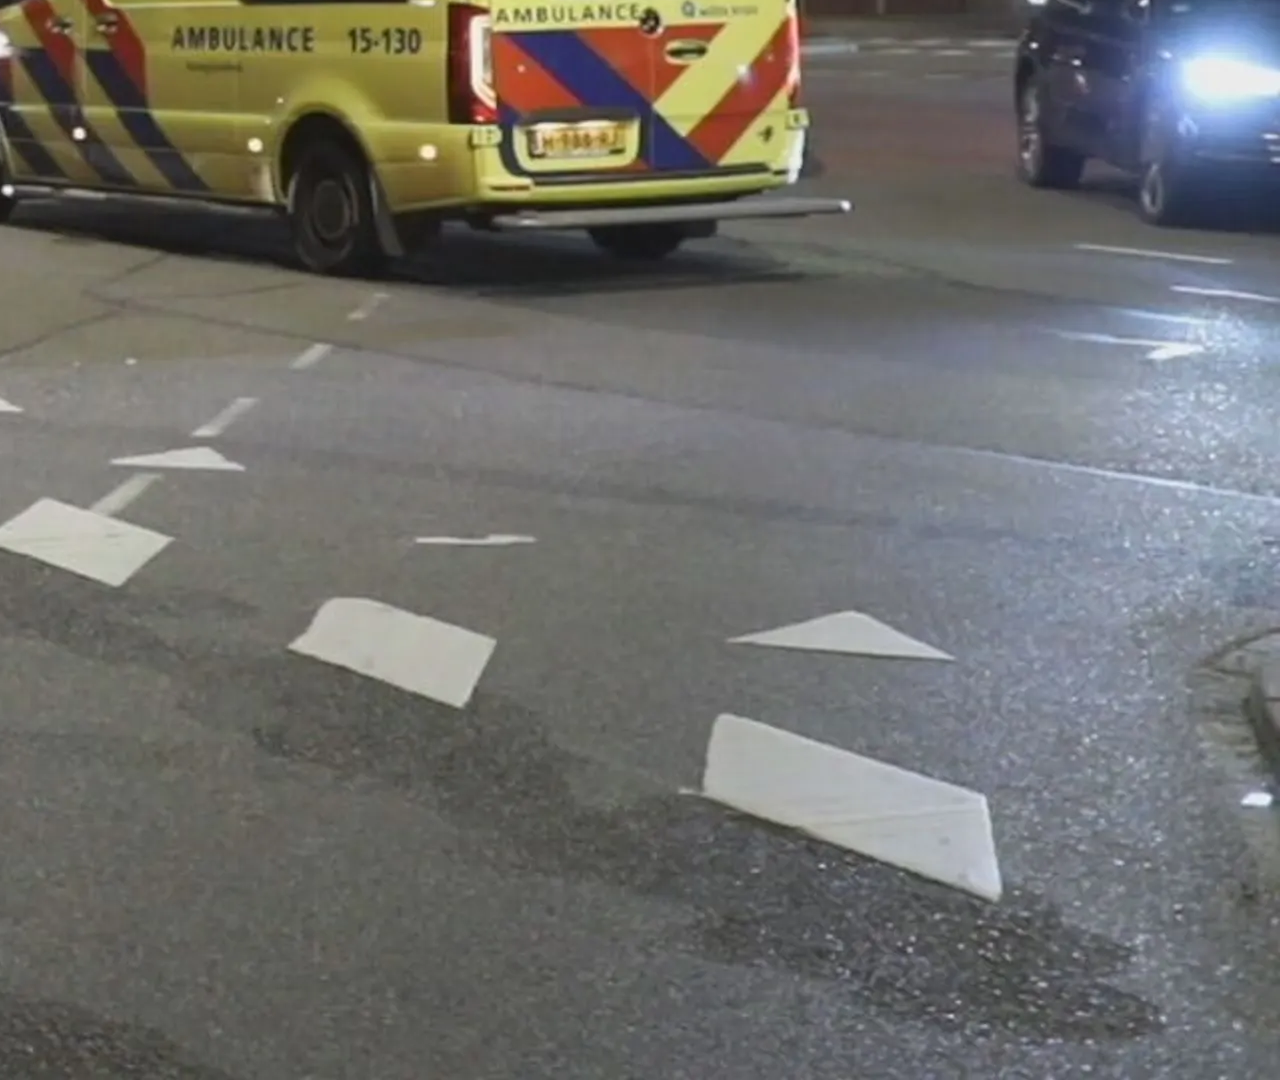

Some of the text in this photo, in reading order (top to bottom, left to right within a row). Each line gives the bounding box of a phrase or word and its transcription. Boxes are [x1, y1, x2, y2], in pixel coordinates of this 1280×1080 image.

[495, 3, 640, 23] AMBULANCE
[171, 25, 422, 55] AMBULANCE 15-130
